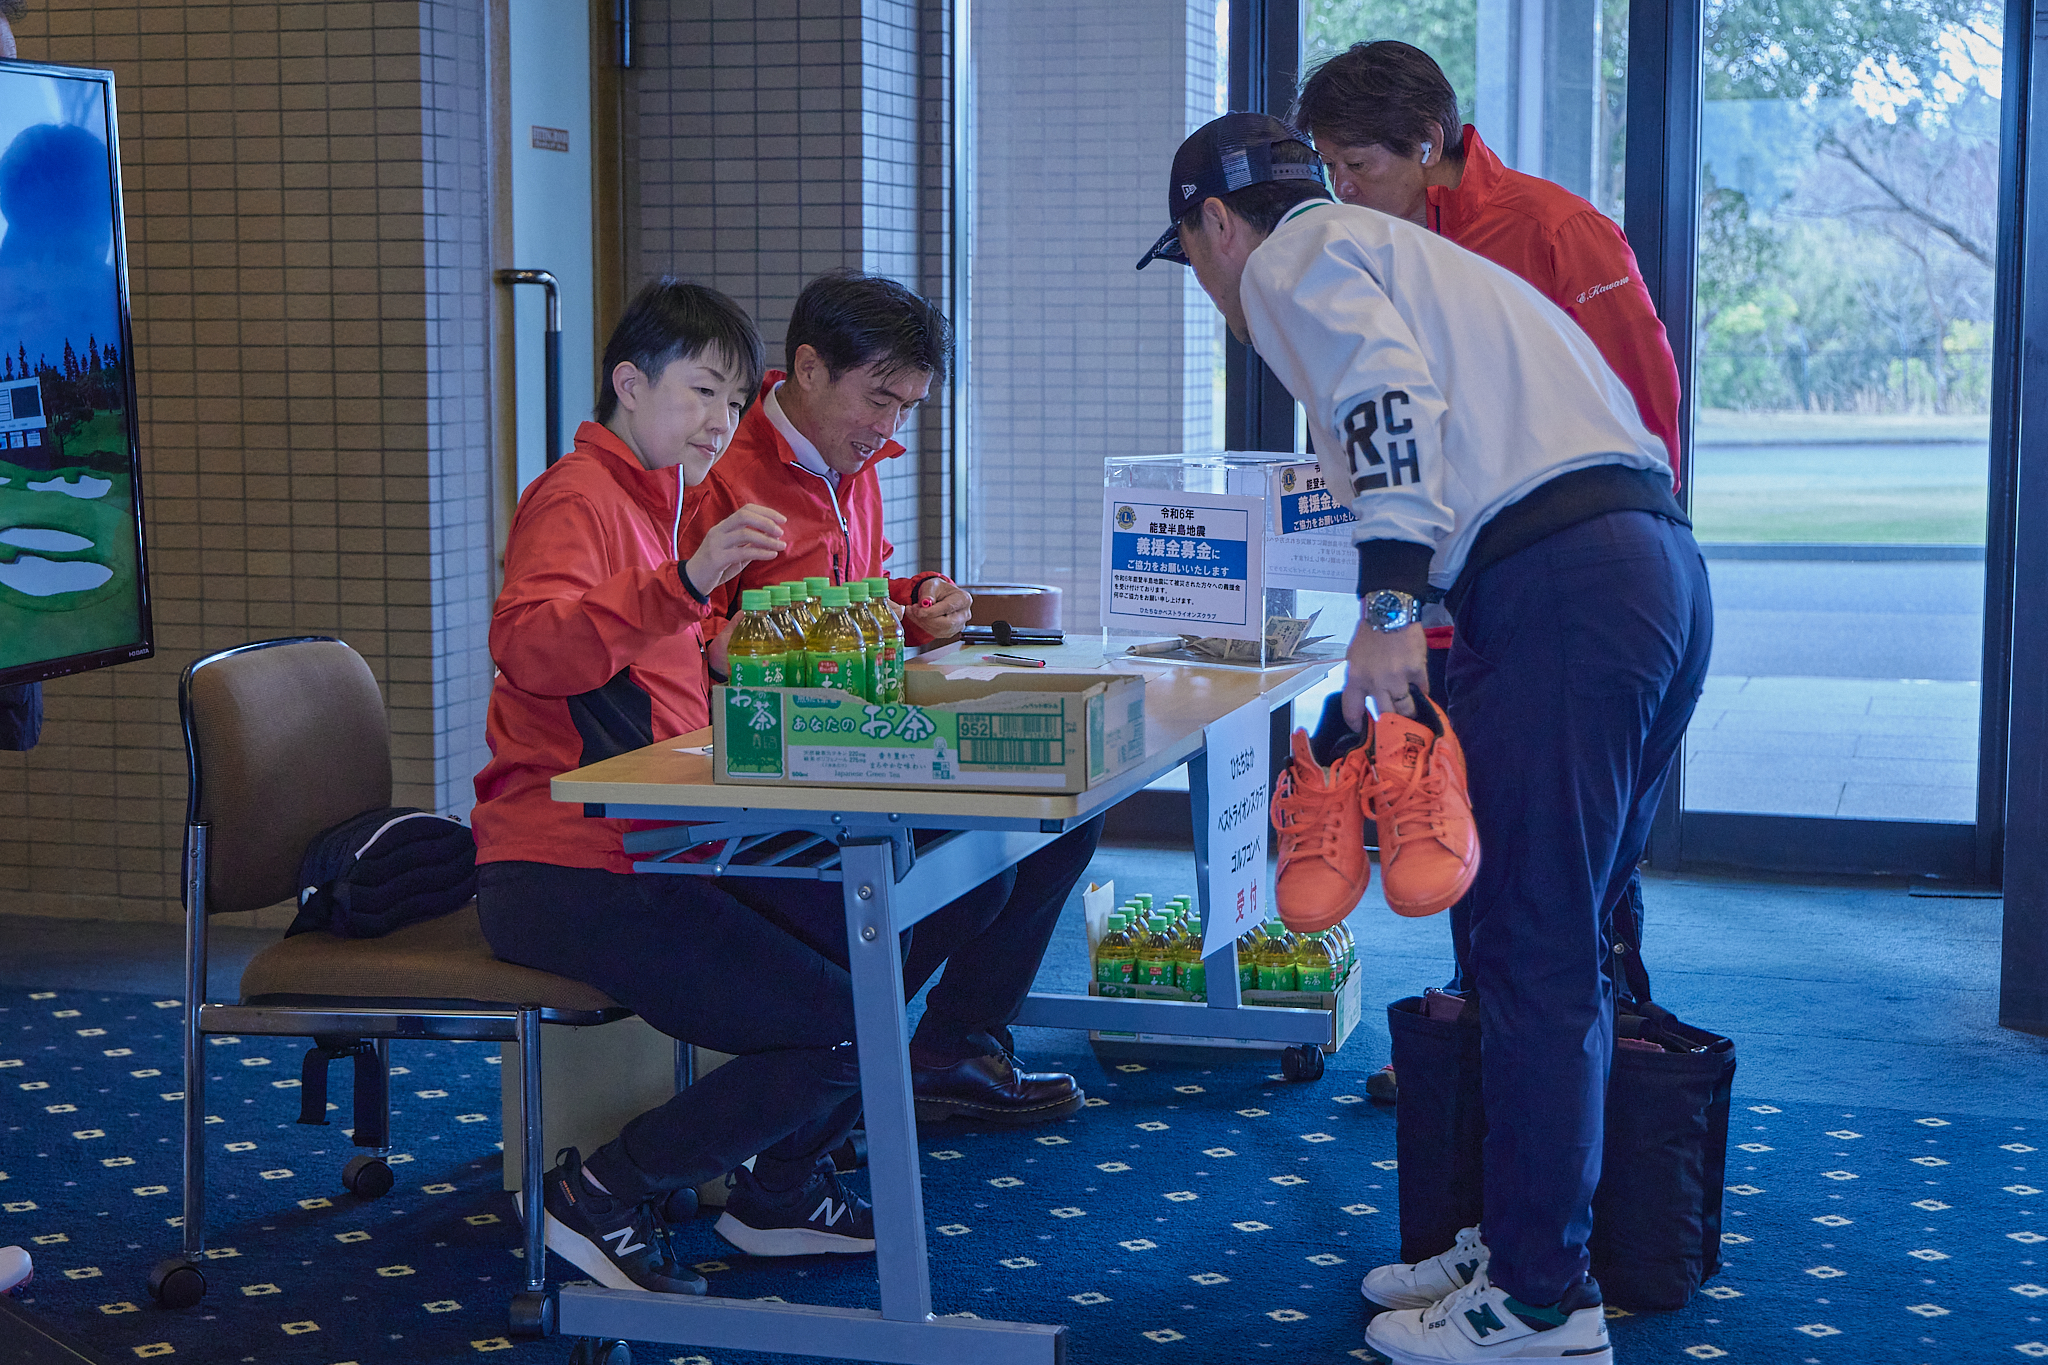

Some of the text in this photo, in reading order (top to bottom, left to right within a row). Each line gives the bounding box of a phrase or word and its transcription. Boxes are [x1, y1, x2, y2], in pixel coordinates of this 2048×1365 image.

[1160, 507, 1195, 520] 令和6年
[1293, 511, 1360, 531] ご協力をお願いいたし
[1149, 522, 1206, 537] 能登半島地震
[1136, 537, 1221, 560] 義援金募金に
[1127, 559, 1229, 577] ご協力をお願いいたします
[960, 722, 989, 737] 952
[1230, 746, 1255, 780] ひたちなか
[1231, 835, 1262, 874] ゴルフコンペ
[1235, 878, 1258, 923] 受付
[1428, 1318, 1447, 1330] 550
